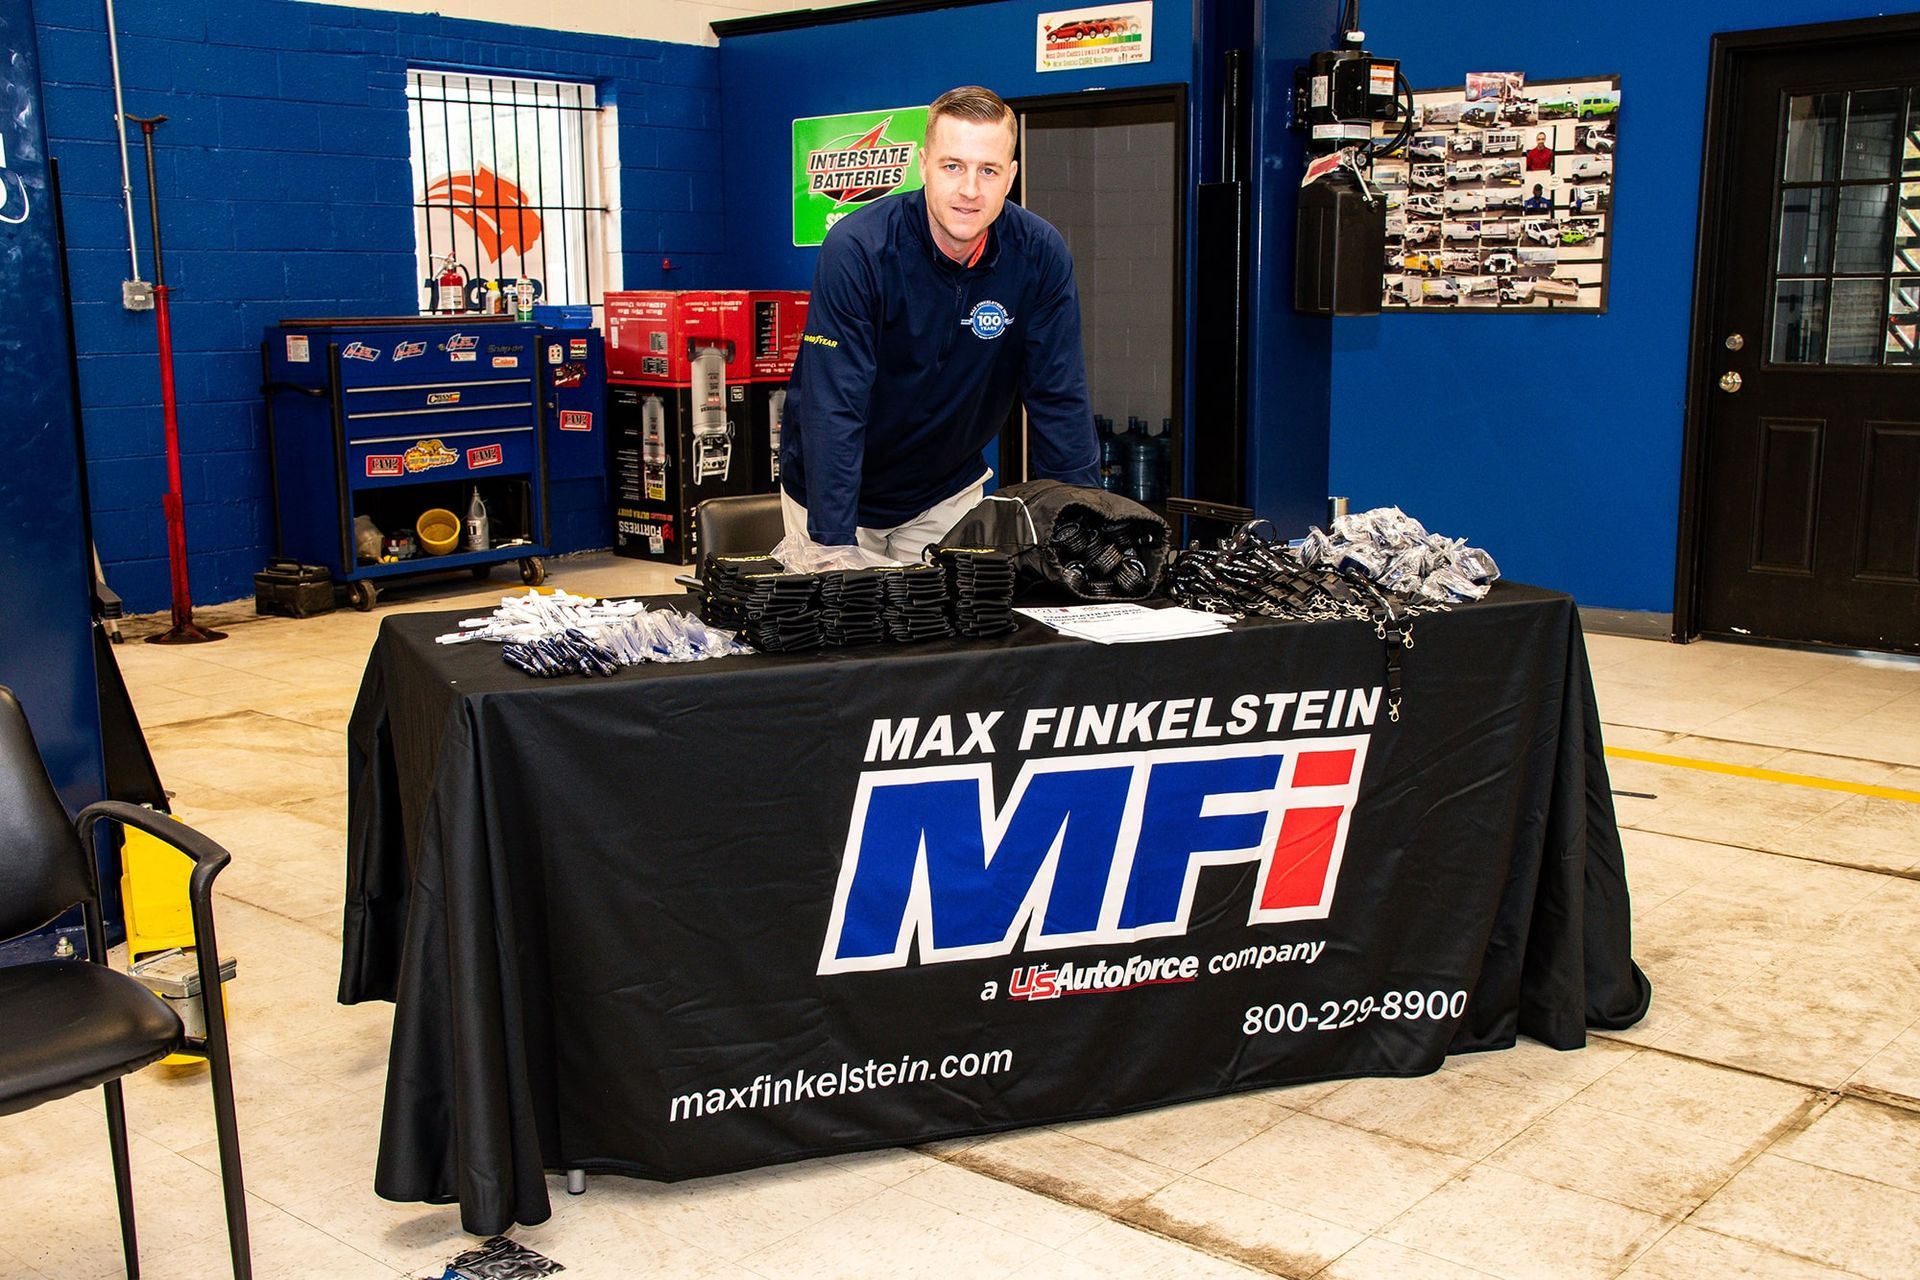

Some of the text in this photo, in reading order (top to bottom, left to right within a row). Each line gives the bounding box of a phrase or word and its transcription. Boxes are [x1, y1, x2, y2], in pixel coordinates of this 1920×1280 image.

[810, 146, 910, 170] INTERSTATE
[812, 168, 903, 190] BATTERIES
[977, 315, 1002, 327] 100
[371, 458, 399, 470] CAM2
[618, 520, 662, 537] FORTRESS
[863, 686, 1383, 762] MAX FINKELSTEIN
[980, 979, 998, 1001] a
[1208, 940, 1326, 975] company
[1242, 990, 1467, 1035] 800-229-8900
[669, 1048, 1013, 1122] maxfinkelstein.com
